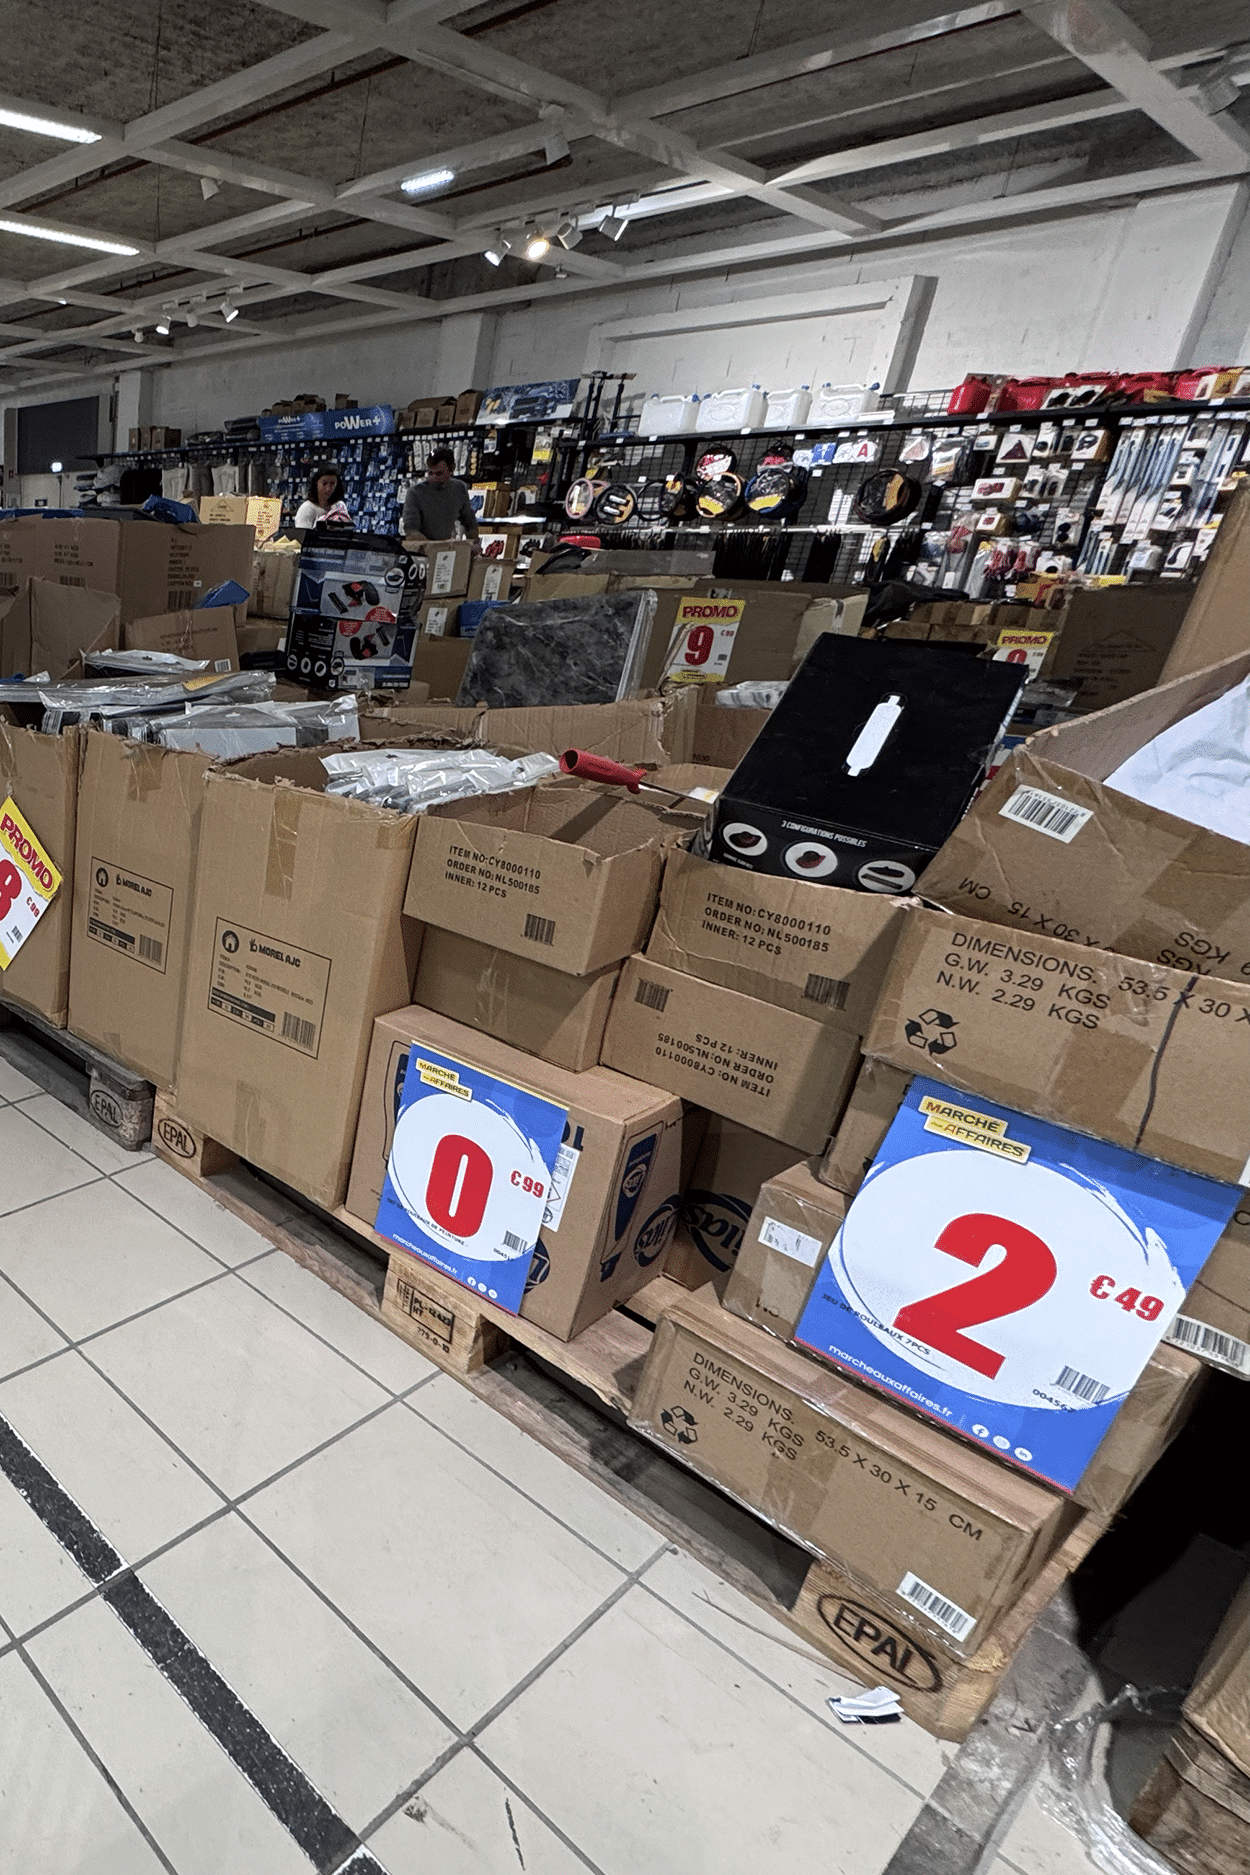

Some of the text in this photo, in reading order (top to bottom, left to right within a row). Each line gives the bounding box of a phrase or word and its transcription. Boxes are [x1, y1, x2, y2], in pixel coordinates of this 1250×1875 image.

[335, 415, 381, 430] POWER+
[682, 606, 737, 618] PROMO
[685, 625, 714, 665] 9
[1002, 636, 1047, 645] PROMO
[0, 812, 54, 891] PROMO
[447, 858, 477, 876] ORDER
[449, 845, 471, 860] ITEM
[445, 871, 507, 899] INNER: 12 PCS
[958, 877, 991, 900] CM
[704, 907, 742, 927] ORDER
[707, 892, 734, 911] ITEM
[1007, 901, 1031, 919] 15
[702, 920, 782, 956] INNER: 12 PCS
[1053, 923, 1080, 943] 30
[1174, 932, 1230, 964] KGS
[258, 944, 301, 968] MOREL AJC
[944, 952, 1111, 1010] G.W. 3.29 KGS
[1118, 976, 1170, 1001] 53.5
[1199, 998, 1231, 1017] 30
[937, 970, 1100, 1030] N.W. 2.29 KGS
[695, 1032, 778, 1071] INNER: 12 PCS
[430, 1077, 469, 1097] AFFAIRES
[733, 1061, 775, 1084] ORDER
[742, 1079, 771, 1098] ITEM
[95, 1094, 119, 1124] EPAL
[163, 1121, 190, 1155] EPAL
[945, 1124, 1025, 1157] AFFAIRES
[426, 1134, 493, 1238] 0
[522, 1175, 544, 1199] 99
[892, 1212, 1058, 1381] 2
[1114, 1286, 1165, 1322] 49
[853, 1309, 904, 1341] ROULEAUX
[905, 1338, 931, 1356] 7PCS
[828, 1345, 953, 1417] marcheauxaffaires.fr
[683, 1379, 798, 1461] N.W. 2.29 KGS
[688, 1366, 805, 1447] G.W. 3.29 KGS
[815, 1430, 851, 1458] 53.5
[852, 1453, 868, 1469] X
[869, 1464, 892, 1484] 30
[894, 1479, 912, 1497] X
[914, 1492, 937, 1511] 15
[948, 1511, 983, 1542] CM
[833, 1603, 918, 1678] EPAL
